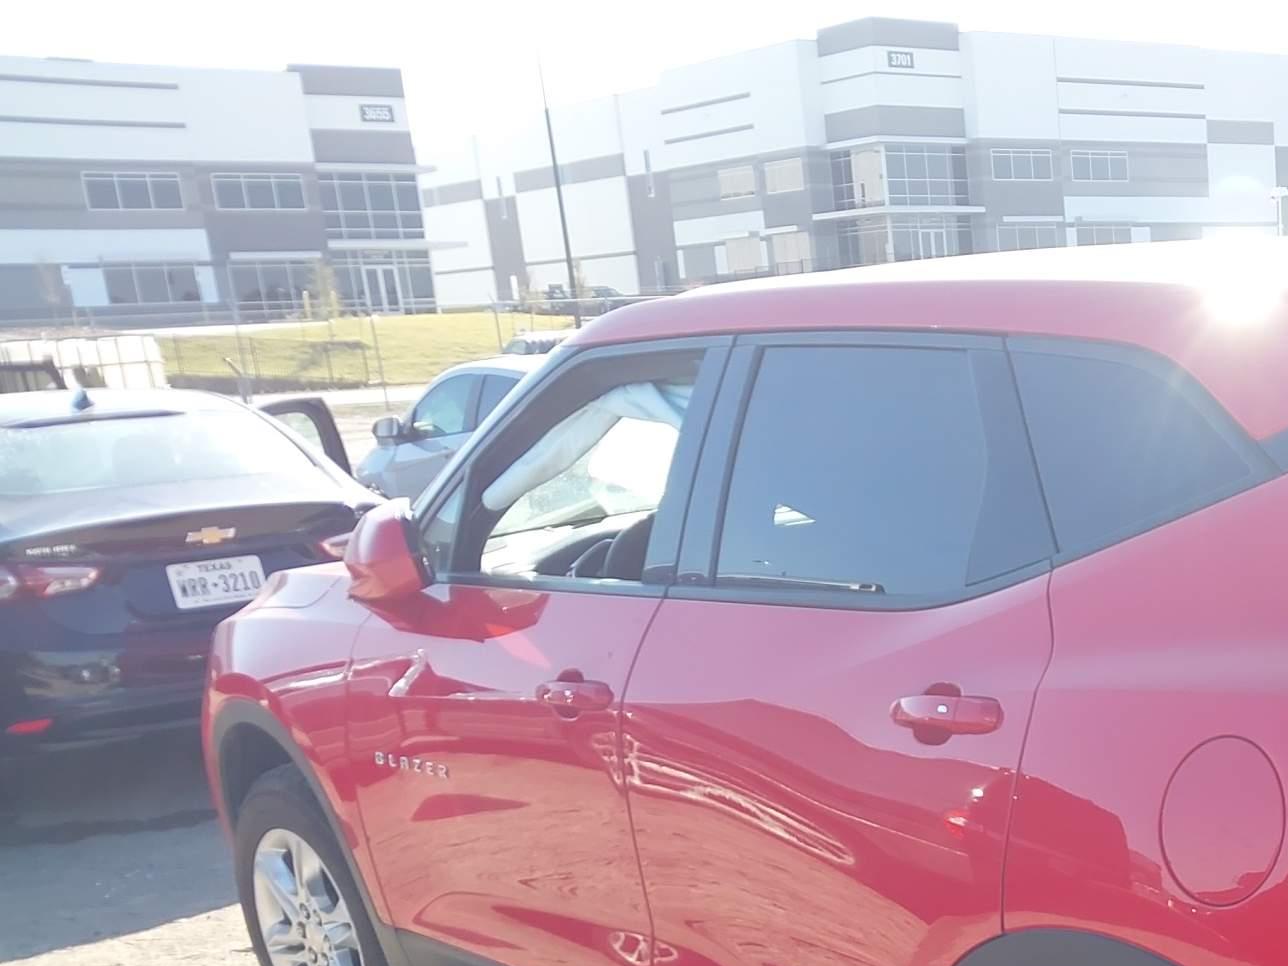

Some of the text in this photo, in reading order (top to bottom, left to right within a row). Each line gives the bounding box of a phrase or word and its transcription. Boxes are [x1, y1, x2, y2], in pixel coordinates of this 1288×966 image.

[890, 54, 911, 65] 3701
[198, 562, 232, 572] TEXAS
[375, 751, 448, 779] BLAZER
